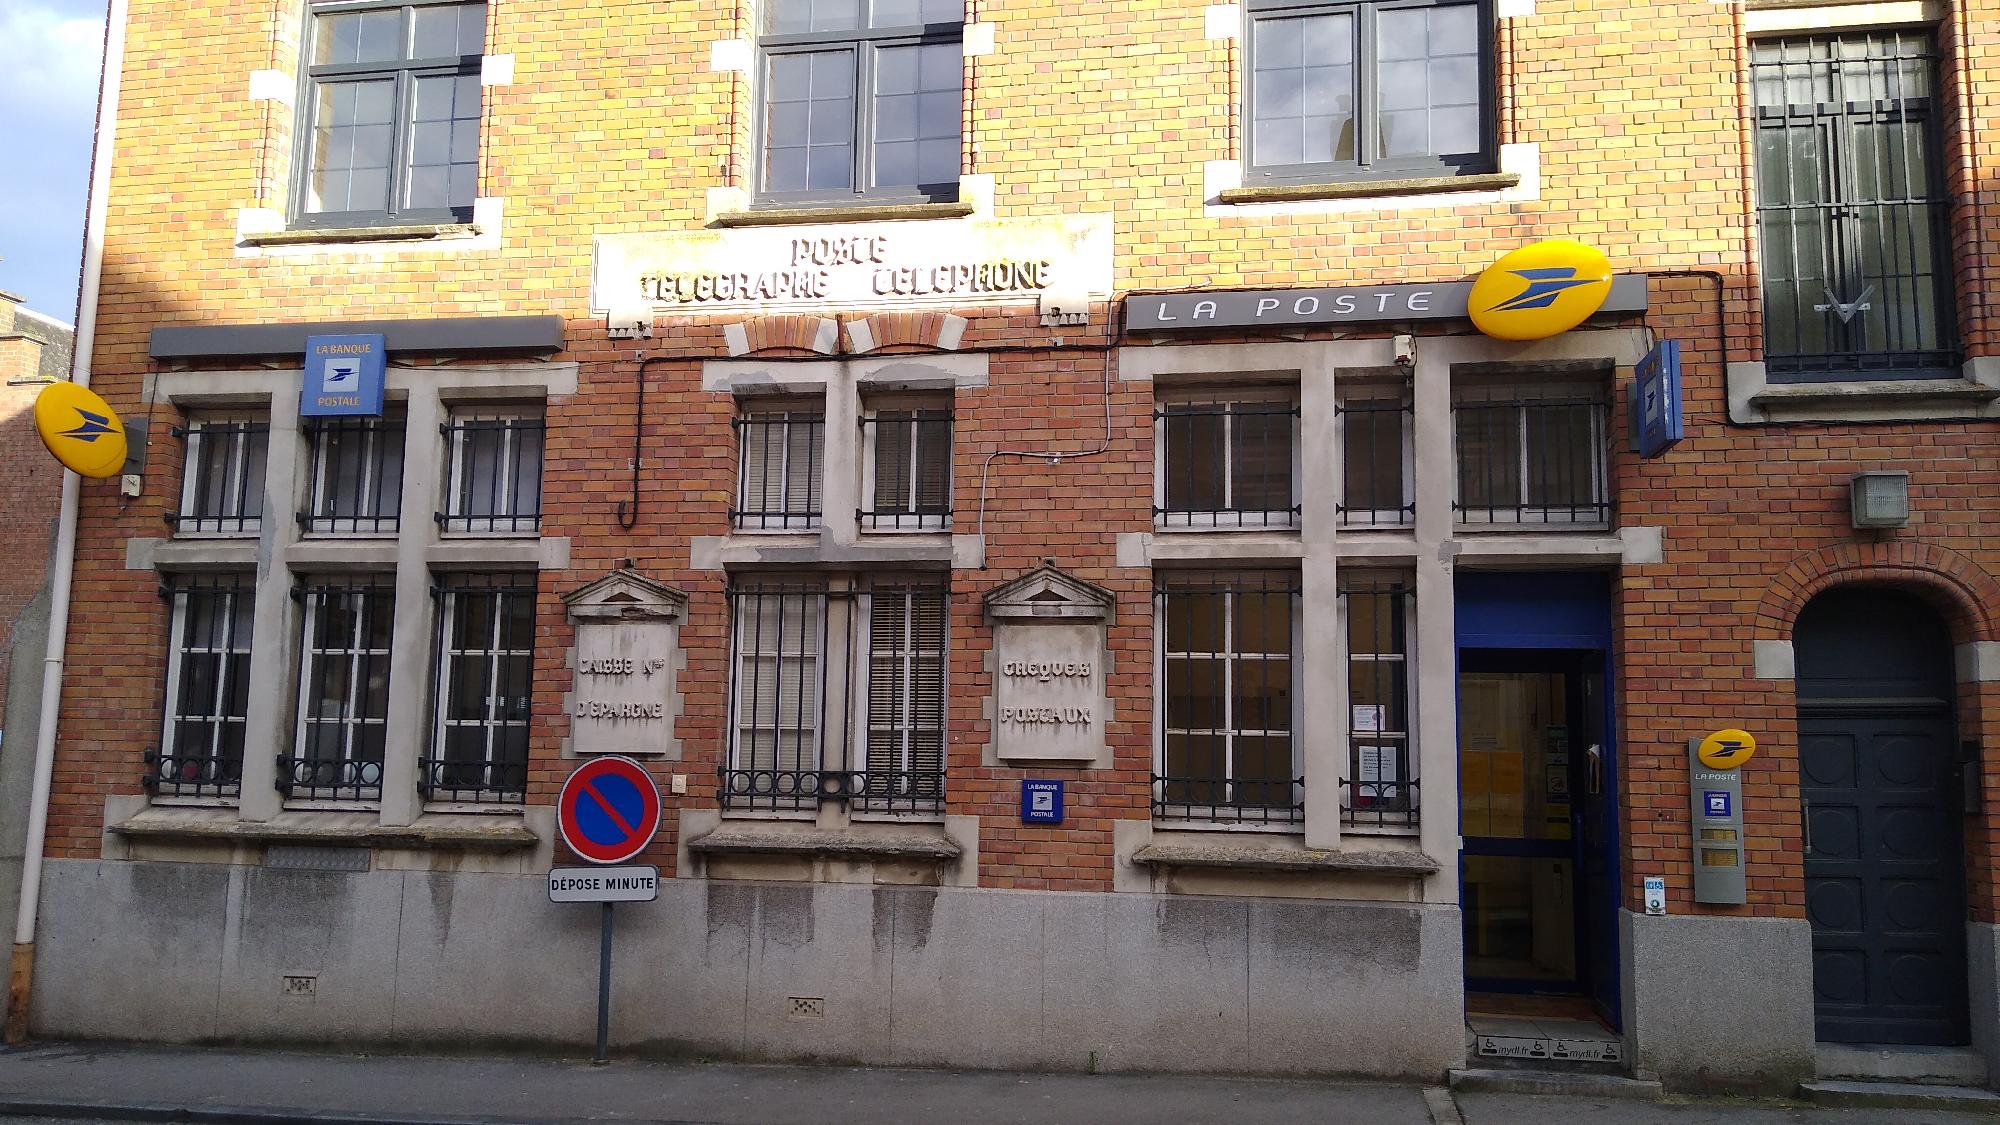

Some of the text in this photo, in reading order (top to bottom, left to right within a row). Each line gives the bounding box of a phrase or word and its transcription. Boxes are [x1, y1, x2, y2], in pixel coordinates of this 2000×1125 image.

[790, 236, 887, 267] POSTE
[1157, 291, 1433, 320] LA POSTE
[316, 343, 372, 355] LA BANQUE
[317, 396, 360, 407] POSTALE
[579, 658, 634, 675] CAISSE
[1027, 783, 1058, 791] LA BANQUE
[551, 876, 654, 890] DÉPOSE MINUTE
